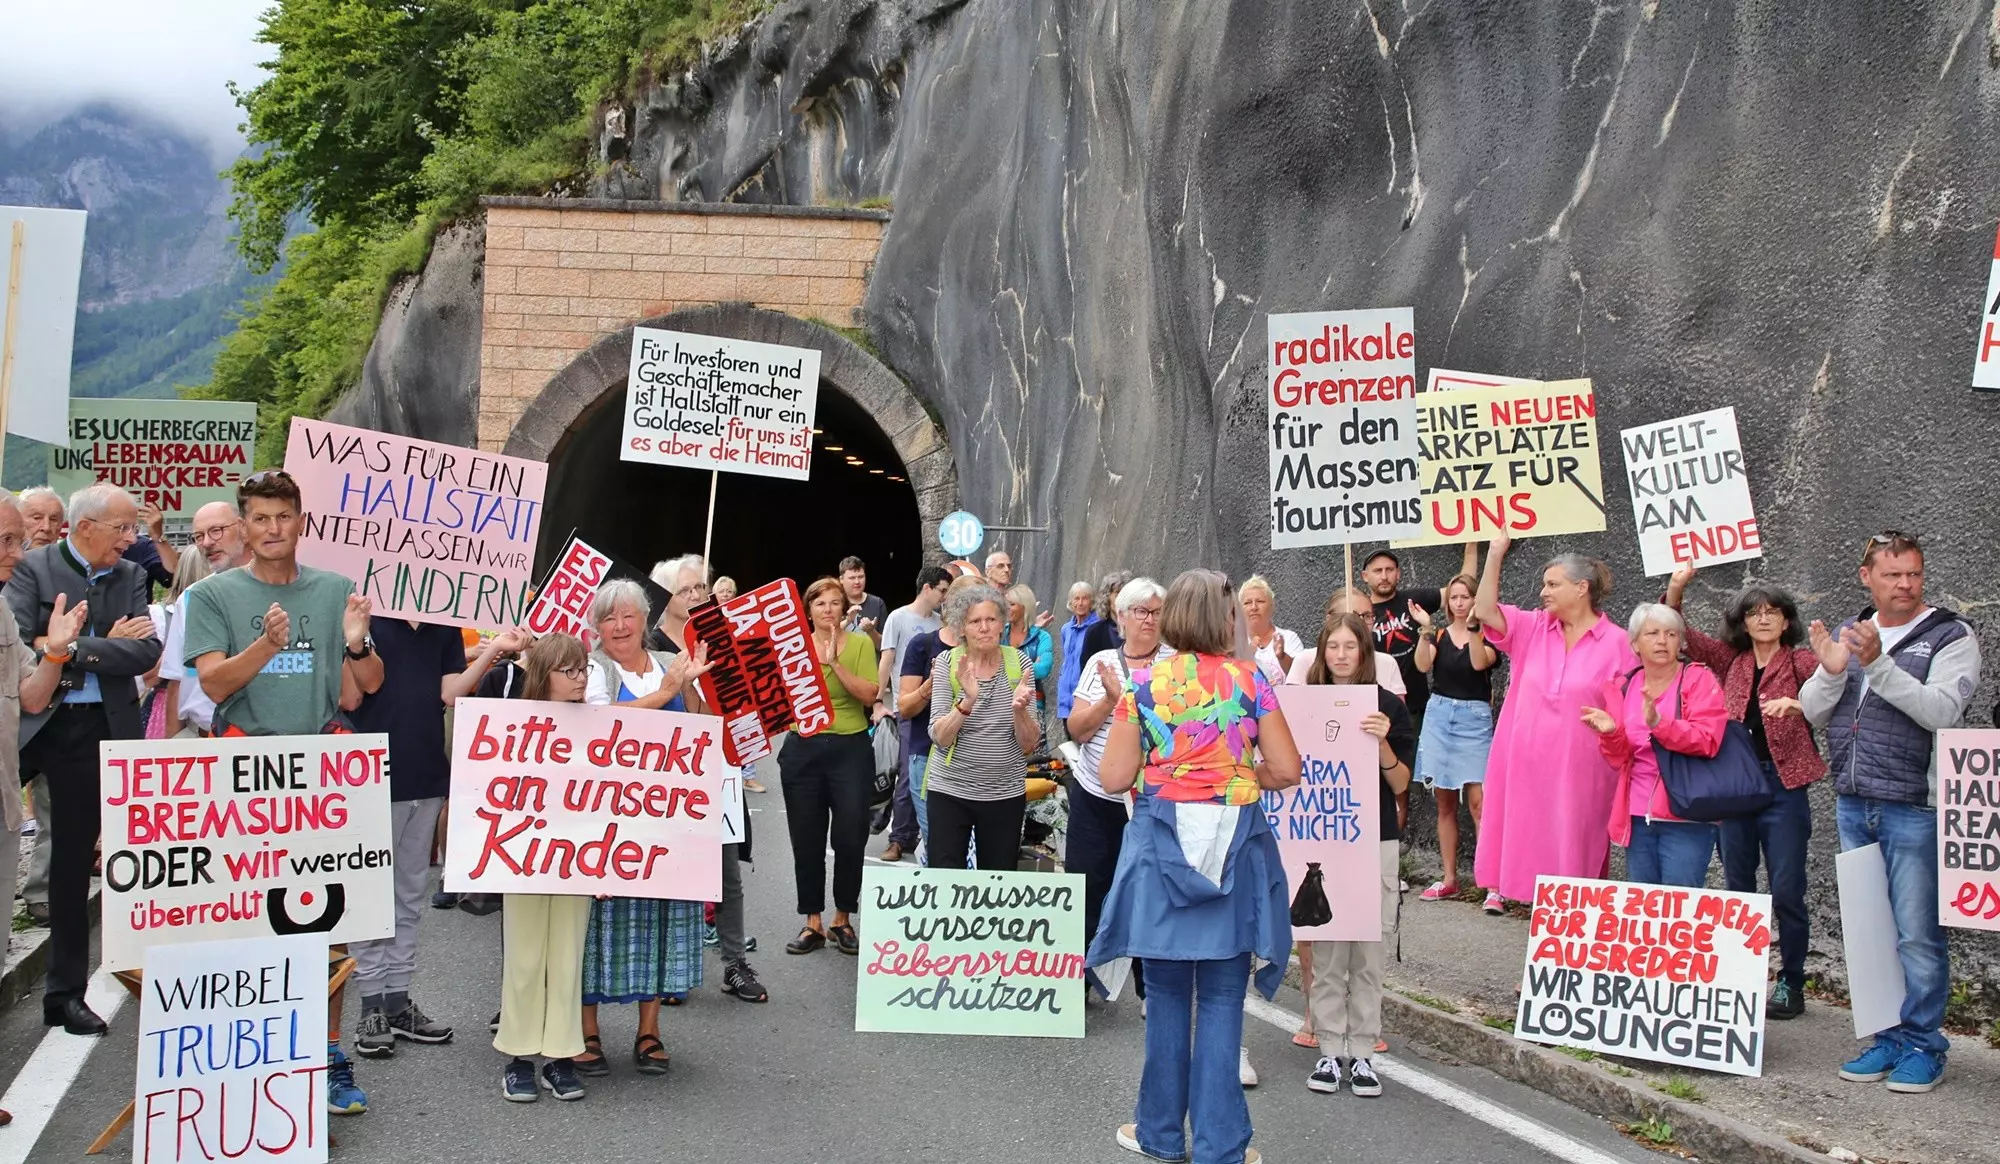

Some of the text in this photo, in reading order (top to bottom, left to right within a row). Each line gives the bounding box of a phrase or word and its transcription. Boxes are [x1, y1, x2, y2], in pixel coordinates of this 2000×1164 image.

[640, 338, 803, 379] Für Investoren und
[1274, 321, 1414, 366] radikale
[635, 384, 806, 424] ist Hallstatt nur ein
[637, 361, 803, 402] Geschäftemacher
[1273, 368, 1416, 408] Grenzen
[727, 417, 753, 443] für
[758, 429, 785, 445] uns
[790, 425, 812, 448] ist
[1272, 407, 1399, 450] für den
[1490, 393, 1596, 427] NEUEN
[92, 442, 247, 465] LEBENSRAUM
[305, 427, 525, 498] WAS FÜR EIN
[630, 432, 812, 471] es aber die Heimat
[1623, 419, 1718, 463] WELT-
[1508, 453, 1606, 516] FÜR
[1631, 449, 1747, 499] KULTUR
[340, 472, 541, 543] HALLSTATT
[1431, 492, 1538, 537] UNS
[1639, 494, 1707, 534] AM
[945, 519, 977, 549] 30
[1670, 518, 1761, 564] ENDE
[486, 550, 528, 571] WIR
[562, 542, 607, 587] ES
[362, 558, 528, 627] KINDERN
[759, 580, 830, 735] TOURISMUS
[468, 714, 712, 776] bitte denkt
[726, 710, 772, 765] NEIN
[107, 755, 219, 806] JETZT
[232, 753, 308, 793] EINE
[486, 775, 548, 812] an
[563, 779, 710, 820] unsere
[1289, 787, 1361, 815] MÜLL
[128, 793, 348, 845] BREMSUNG
[1289, 814, 1361, 843] NICHTS
[468, 806, 669, 880] Kinder
[106, 841, 392, 893] ODER wir werden
[130, 890, 264, 931] überrollt
[871, 870, 1073, 912] wir müssen
[898, 915, 1056, 946] unseren
[1530, 908, 1716, 953] FÜR BILLIGE
[1536, 882, 1772, 956] KEINE ZEIT MEHR
[866, 939, 1085, 980] Lebensraum
[1532, 936, 1719, 984] AUSREDEN
[154, 957, 304, 1013] WIRBEL
[886, 975, 1062, 1015] schützen
[1528, 964, 1758, 1027] WIR BRAUCHEN
[146, 1008, 311, 1078] TRUBEL
[1520, 999, 1759, 1068] LÖSUNGEN
[145, 1066, 328, 1164] FRUST
